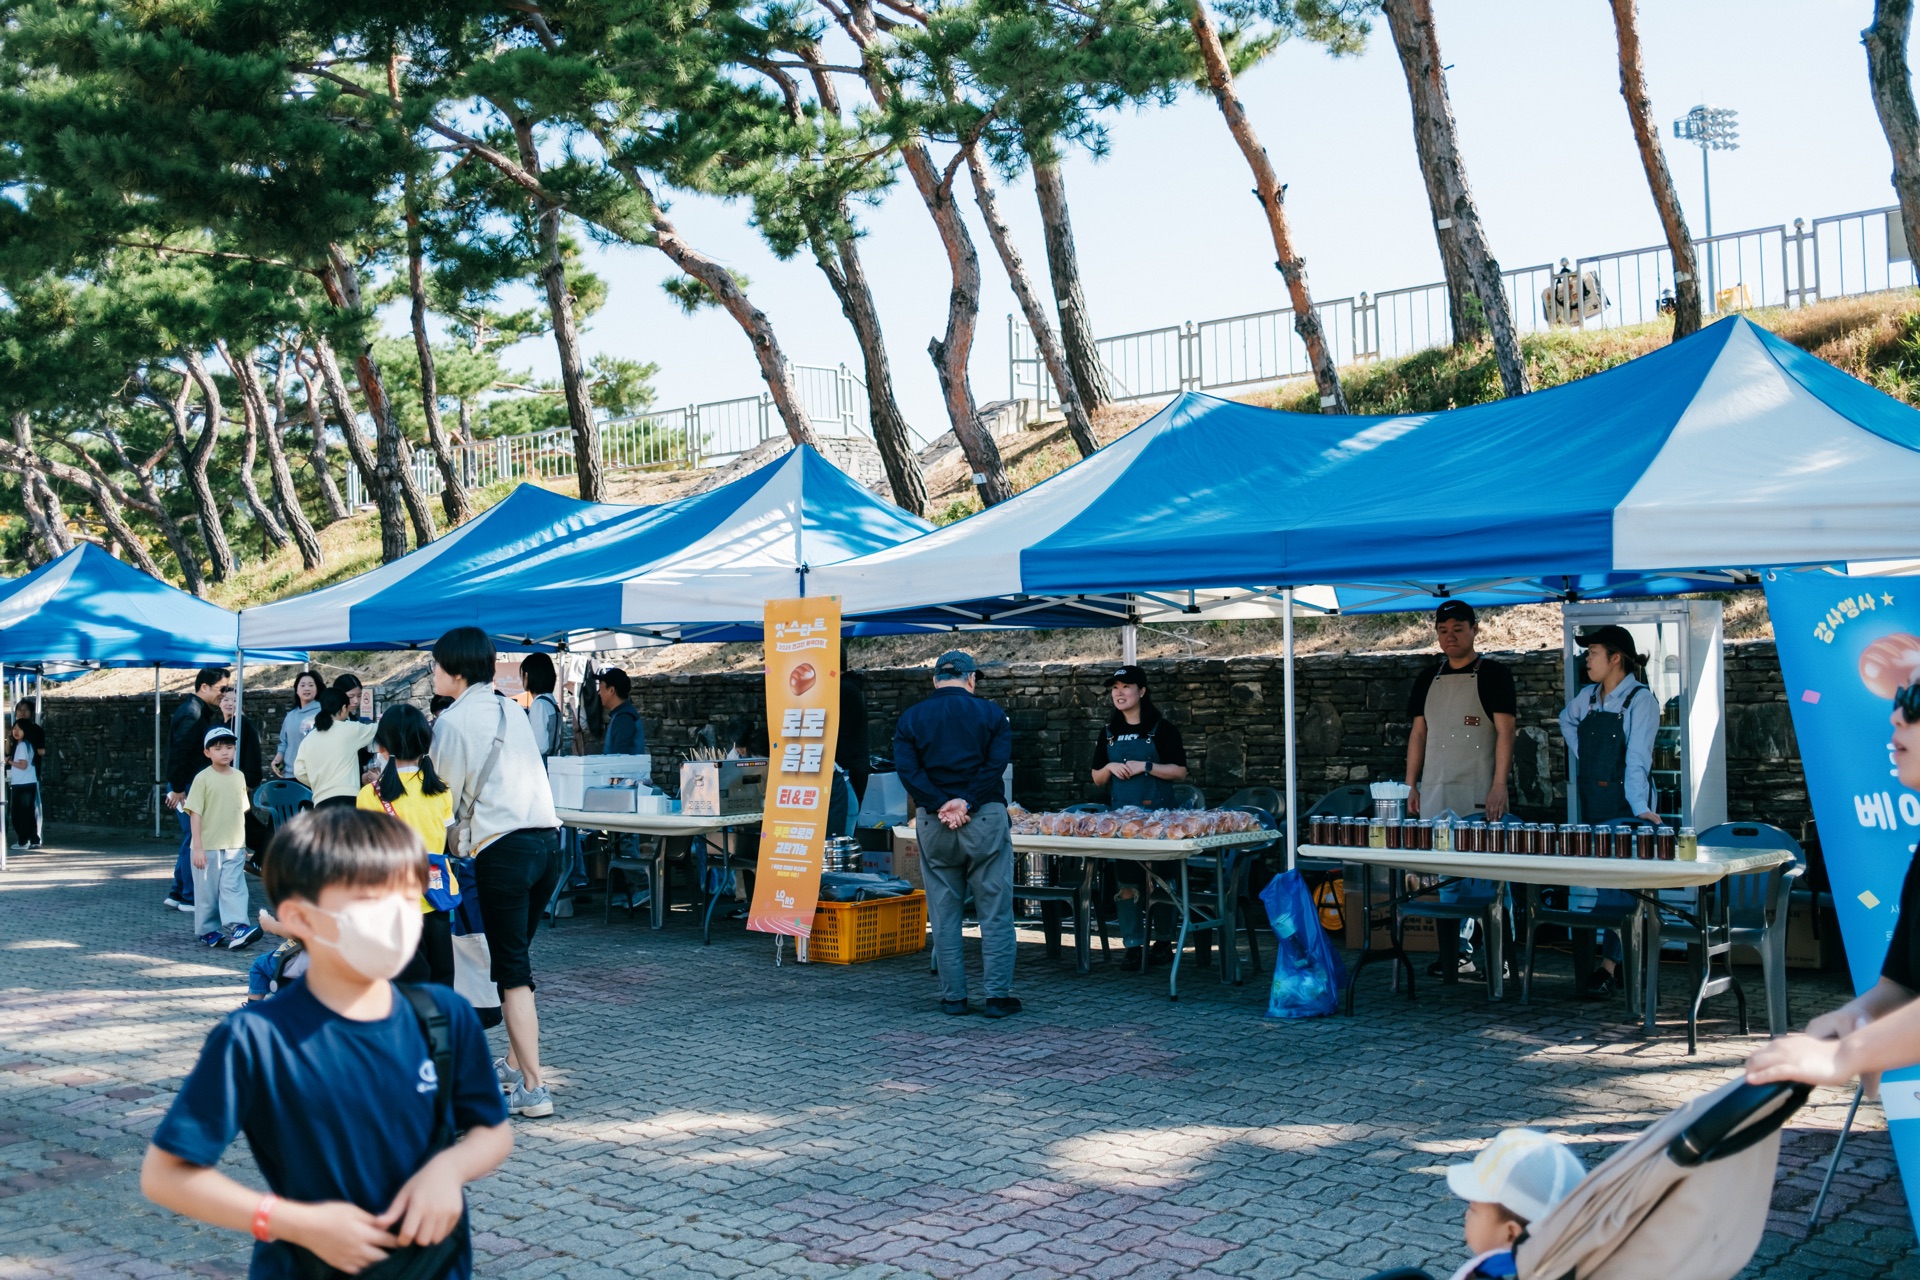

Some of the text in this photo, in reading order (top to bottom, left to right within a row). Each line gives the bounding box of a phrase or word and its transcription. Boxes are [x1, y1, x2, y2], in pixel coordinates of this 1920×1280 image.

[1813, 592, 1876, 644] 감사행사
[780, 743, 824, 772] 음료
[779, 788, 817, 806] 티&빵
[773, 826, 815, 840] 쿠폰으로만
[775, 841, 808, 856] 교환가능
[775, 889, 786, 899] LO
[785, 896, 795, 906] RO
